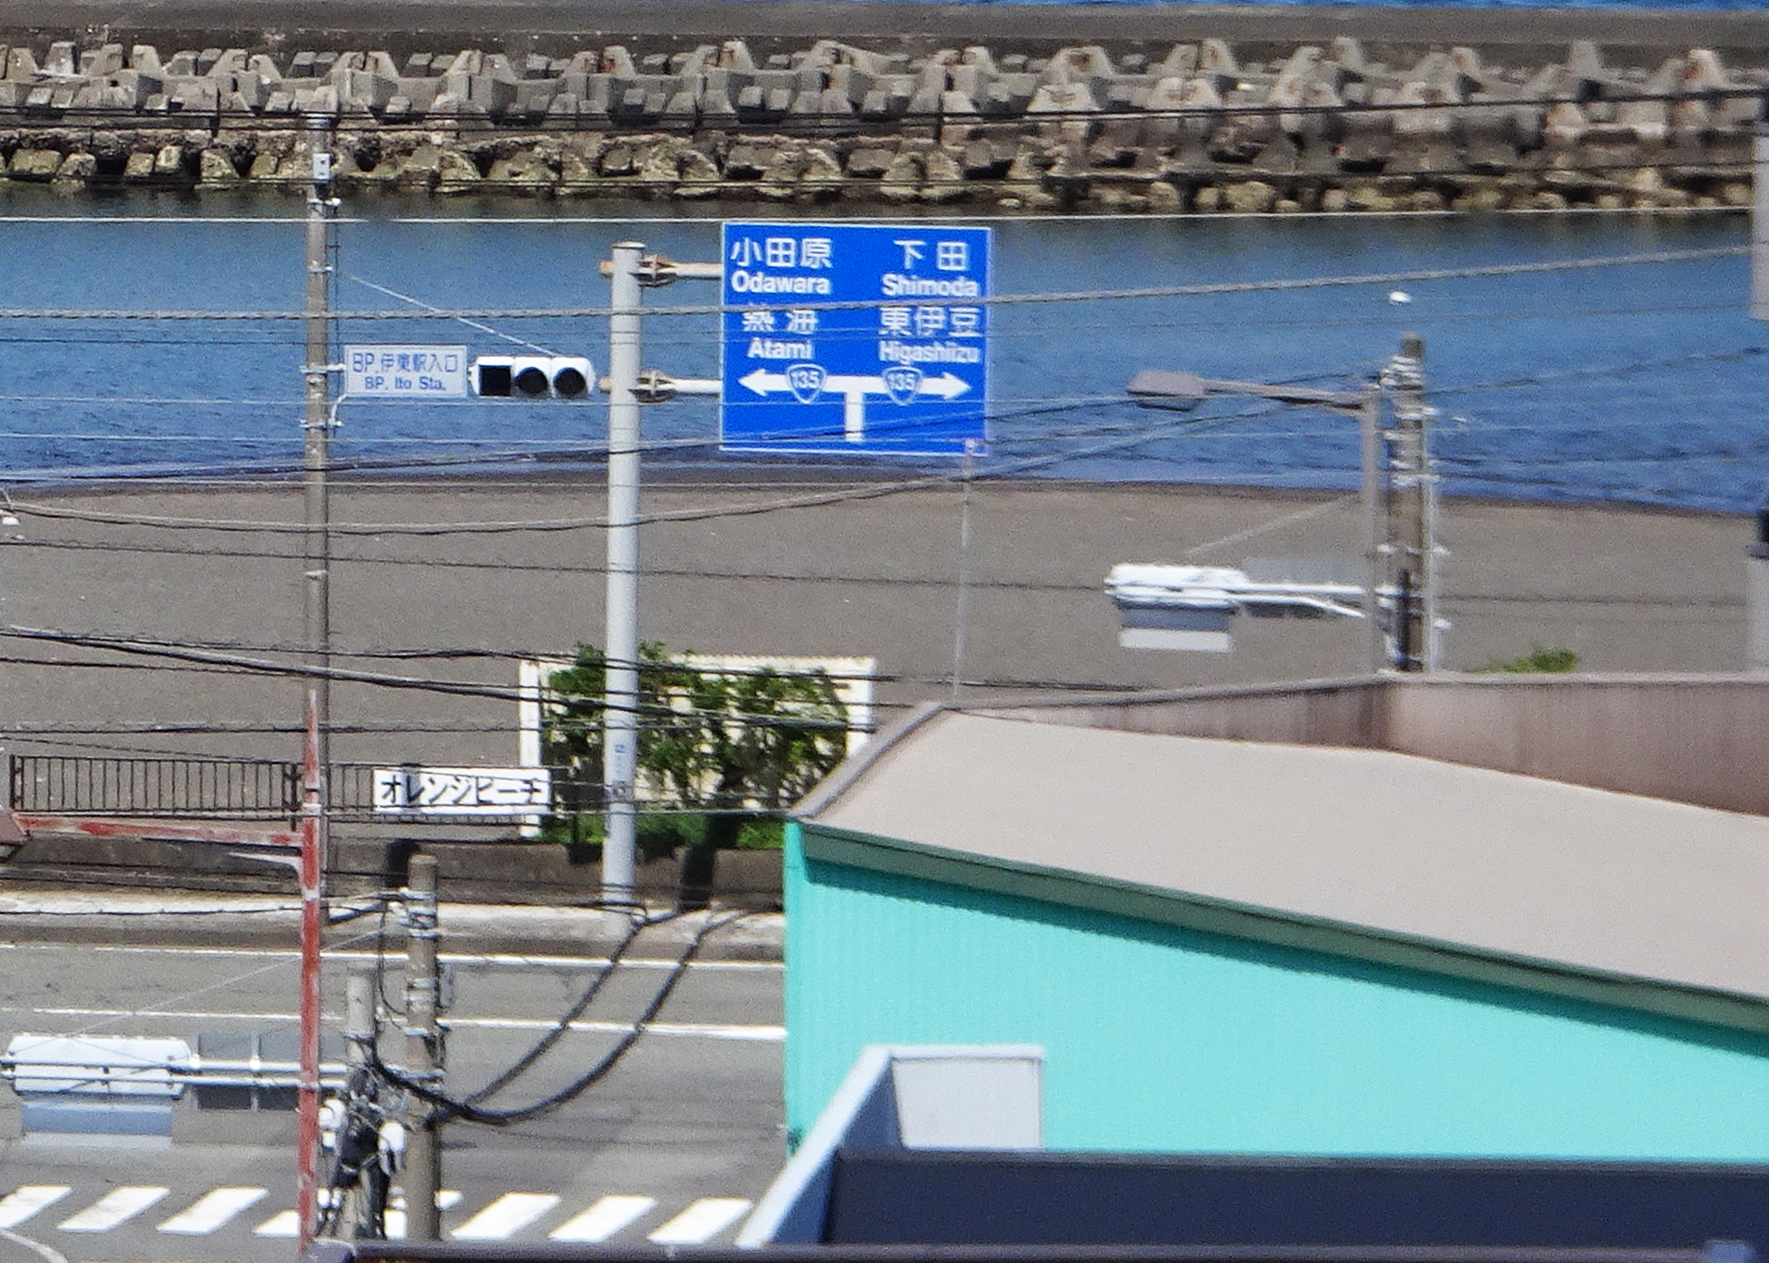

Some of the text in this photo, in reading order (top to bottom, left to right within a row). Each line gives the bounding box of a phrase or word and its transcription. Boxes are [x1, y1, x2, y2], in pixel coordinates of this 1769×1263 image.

[730, 237, 833, 269] 小田原
[893, 240, 967, 270] 下田
[731, 270, 831, 294] Odawara
[882, 274, 978, 298] Shimoda
[742, 302, 819, 334] 熱海
[880, 305, 982, 337] 東伊豆
[747, 337, 813, 359] Atami
[879, 341, 980, 366] Higashiizu
[395, 376, 412, 390] Ito
[419, 376, 446, 391] Sta.
[792, 370, 820, 389] 135
[888, 372, 915, 391] 135
